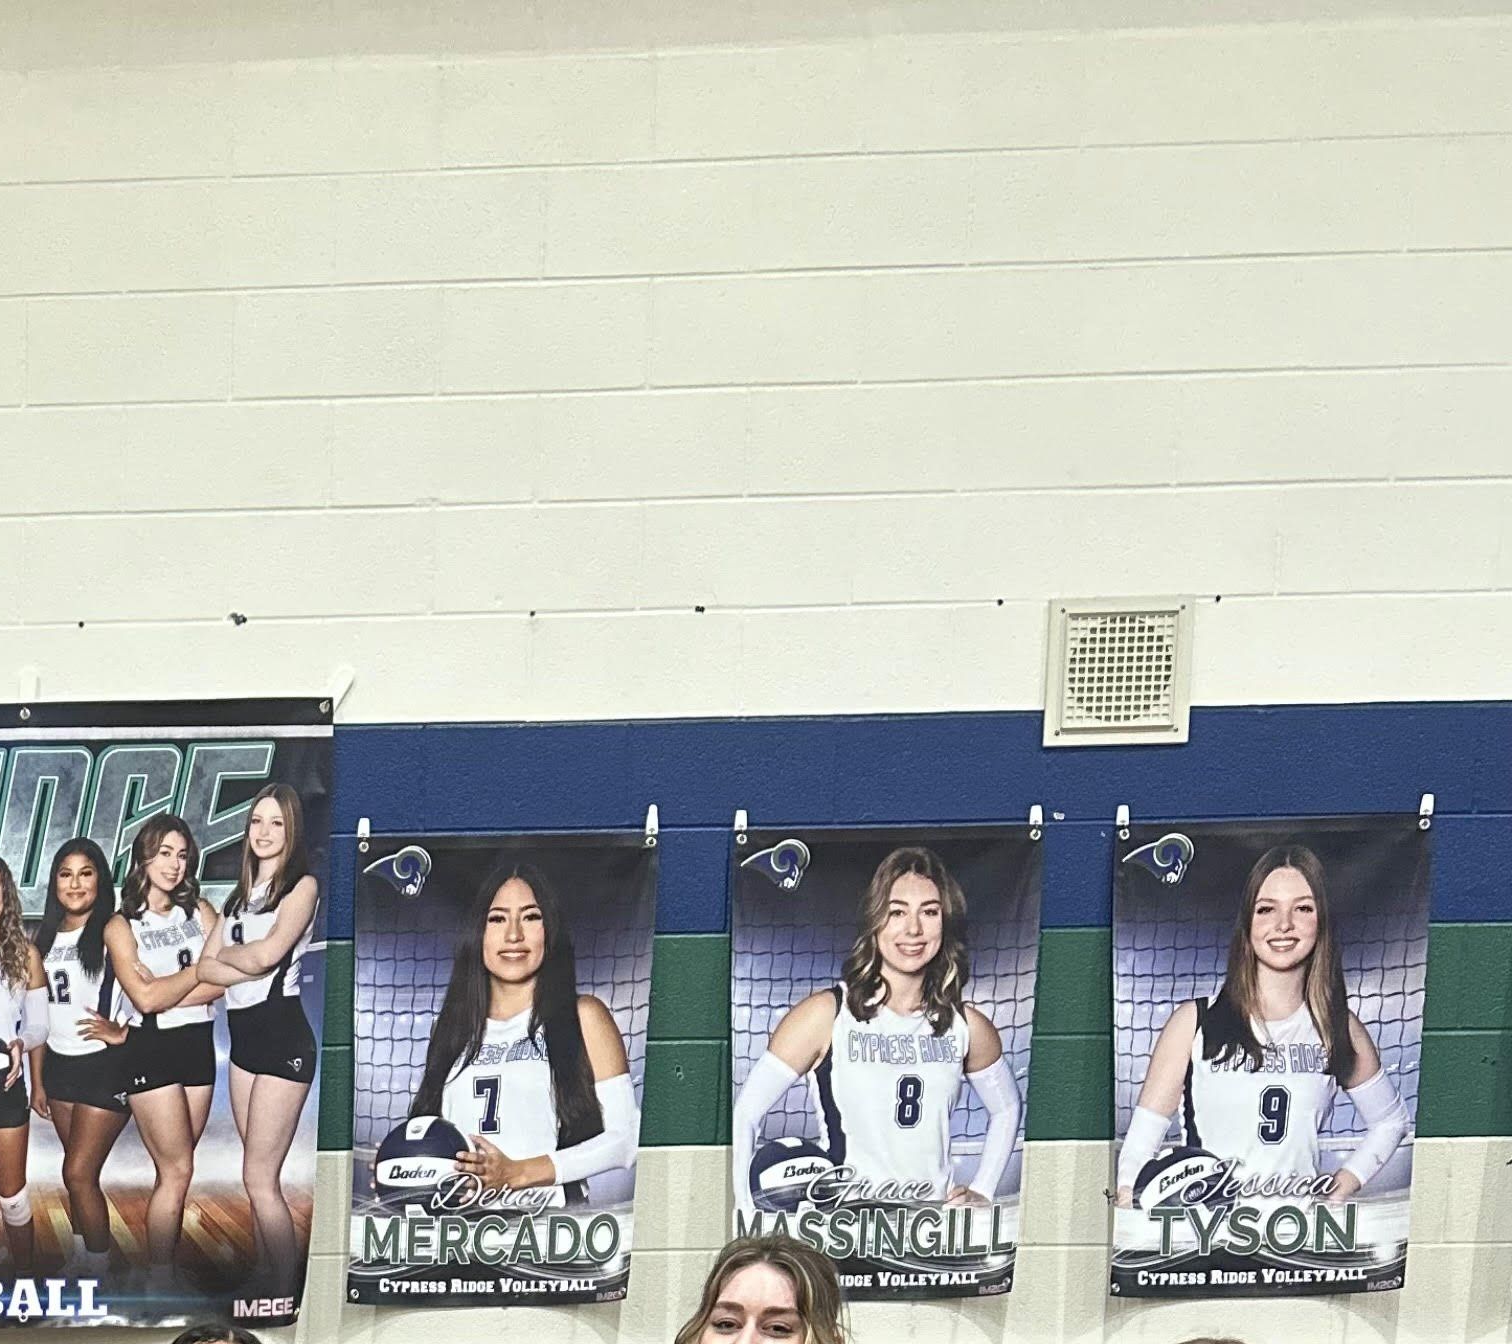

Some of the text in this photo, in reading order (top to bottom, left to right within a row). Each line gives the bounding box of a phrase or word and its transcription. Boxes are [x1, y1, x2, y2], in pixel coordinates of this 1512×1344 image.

[473, 1075, 501, 1134] 7
[895, 1073, 924, 1129] 8
[1258, 1084, 1290, 1145] 9
[389, 1163, 436, 1180] Baden
[431, 1172, 557, 1217] Dercy
[806, 1165, 934, 1206] Grace
[1180, 1158, 1339, 1204] Jessica
[362, 1212, 620, 1266] MERCADO
[736, 1204, 1015, 1259] MASSINGILL
[1148, 1202, 1358, 1256] TYSON
[379, 1277, 597, 1293] CYPRESS RIDGE VOLLEYBALL
[840, 1271, 979, 1287] IDGE VOLLEYBALL
[1138, 1267, 1368, 1286] CYPRESS RIDGE VOLLEYBALL
